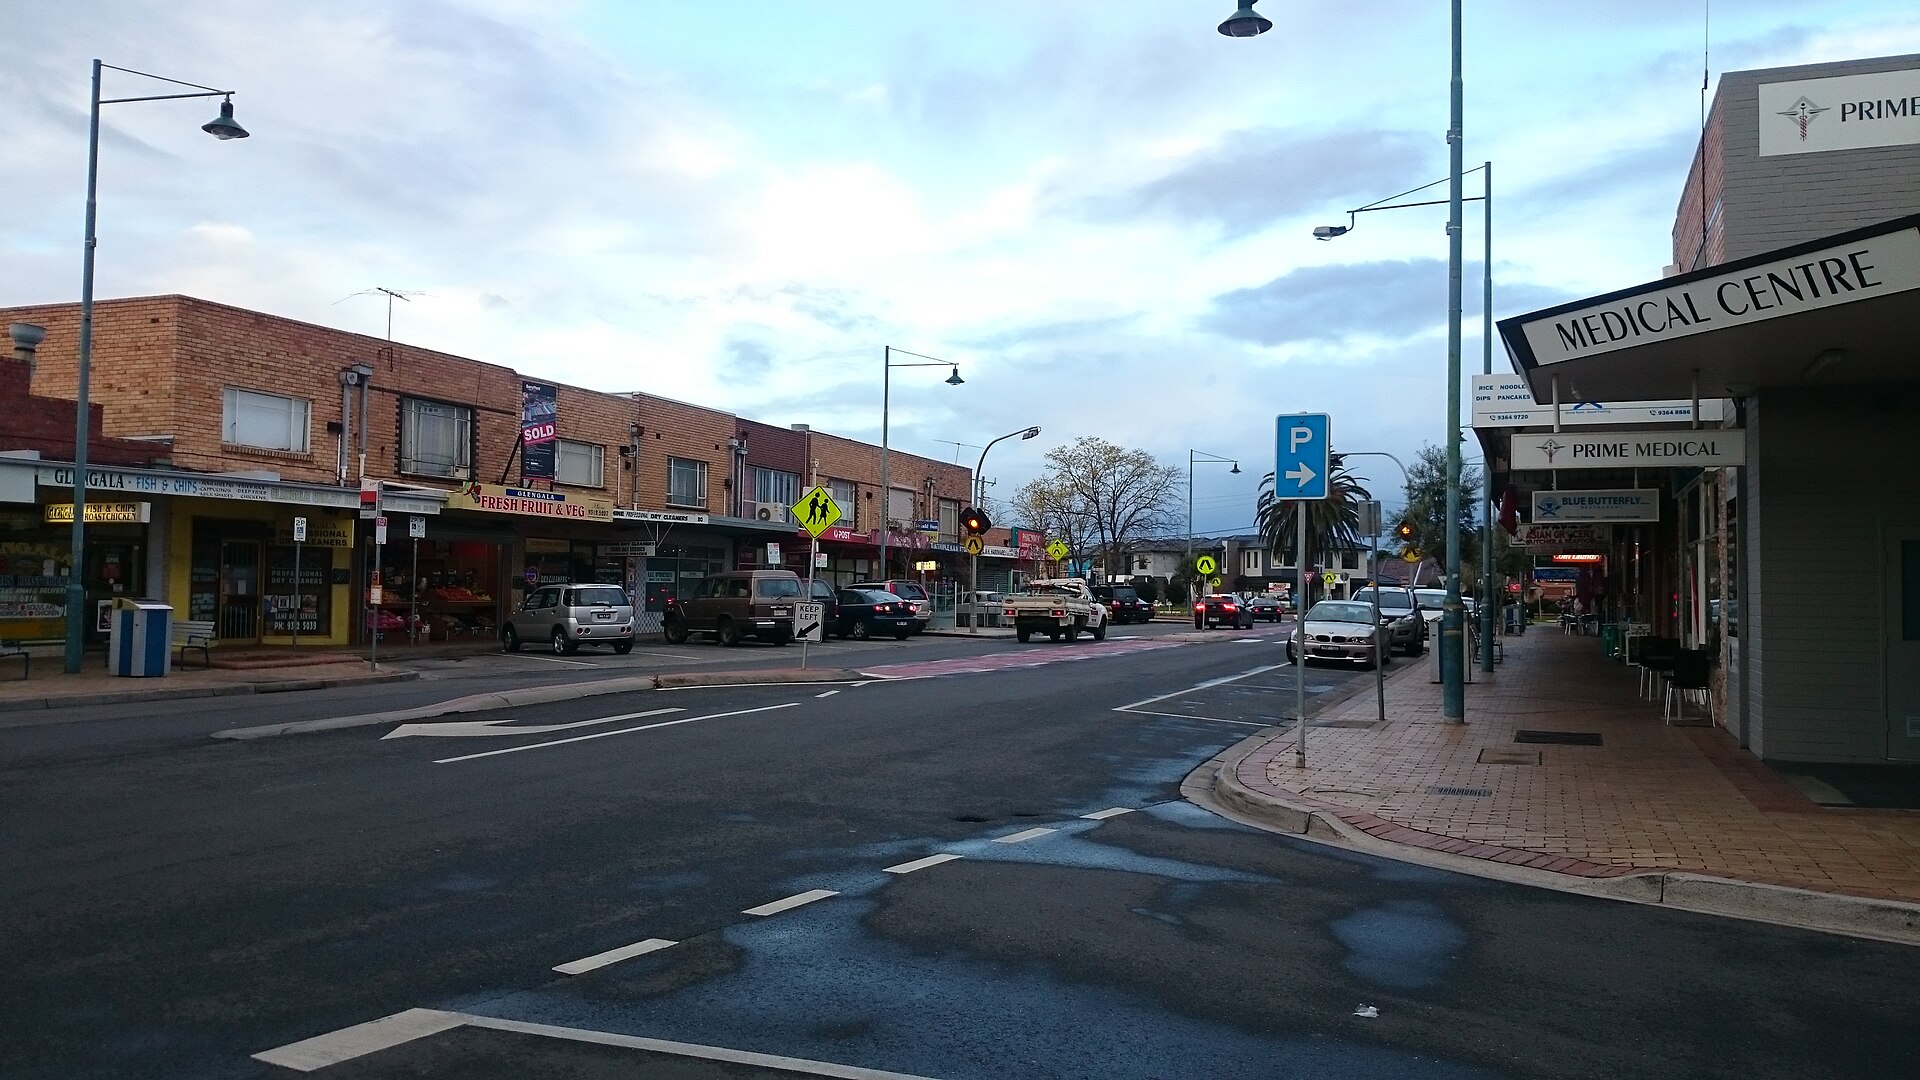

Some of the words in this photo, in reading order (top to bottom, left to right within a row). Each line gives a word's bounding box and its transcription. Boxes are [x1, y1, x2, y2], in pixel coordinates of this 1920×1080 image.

[1841, 96, 1920, 122] PRIME
[1555, 292, 1710, 352] MEDICAL
[1717, 249, 1882, 316] CENTRE
[524, 425, 554, 441] SOLD
[1291, 427, 1313, 453] P
[1573, 443, 1628, 458] PRIME
[1635, 441, 1720, 457] MEDICAL
[137, 477, 157, 490] FISH
[162, 480, 169, 492] &
[174, 479, 198, 494] CHIPS
[517, 490, 554, 500] GLENGALA
[1562, 497, 1586, 505] BLUE
[1588, 496, 1641, 505] BUTTERFLY
[85, 504, 102, 512] FISH
[105, 504, 112, 512] &
[115, 504, 136, 512] CHIPS
[480, 495, 518, 512] FRESH
[520, 500, 553, 515] FRUIT
[555, 502, 564, 516] &
[566, 504, 585, 517] VEG
[838, 531, 850, 539] POST
[800, 613, 817, 621] LEFT
[287, 622, 300, 630] 932
